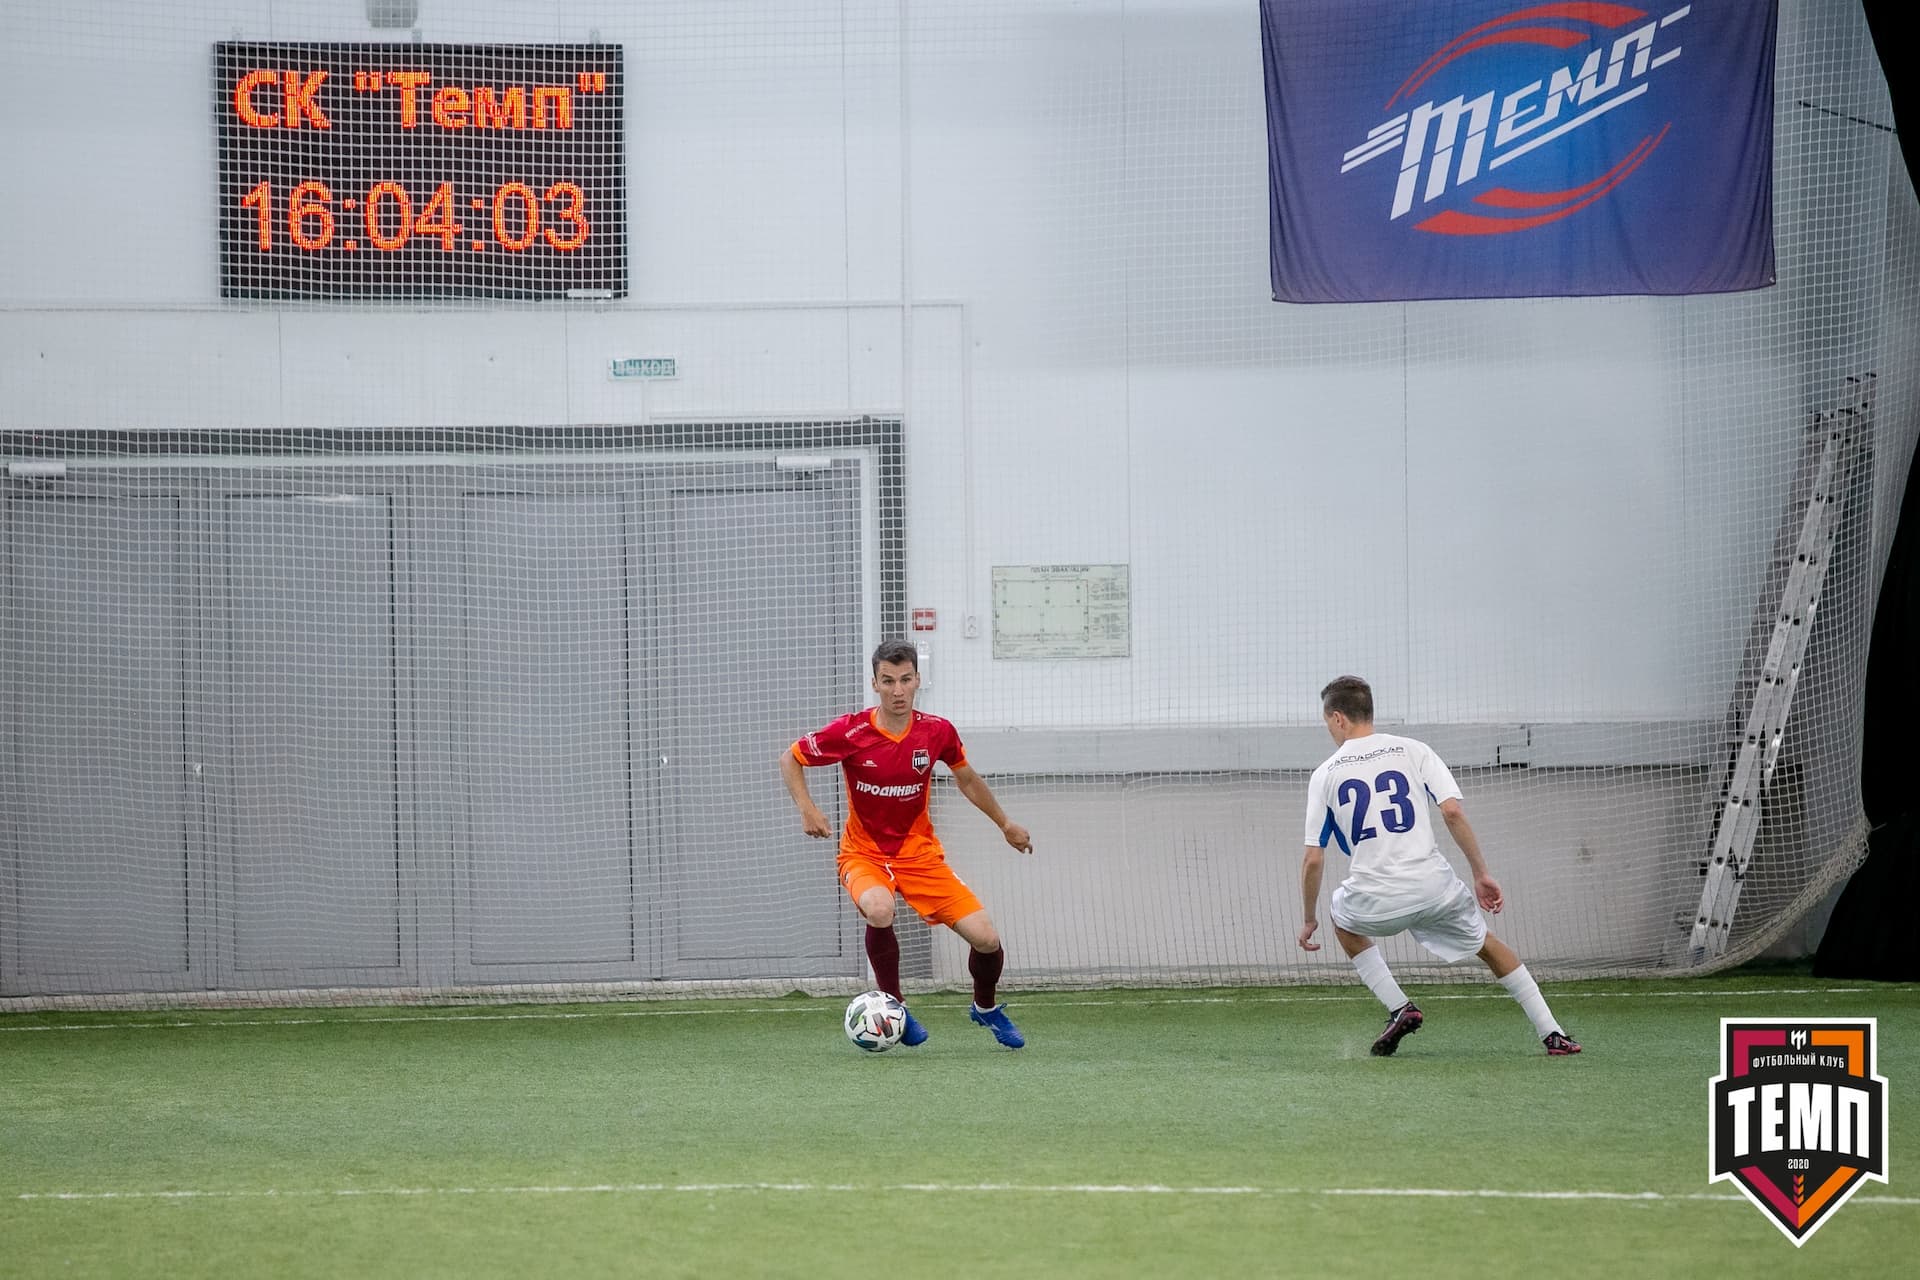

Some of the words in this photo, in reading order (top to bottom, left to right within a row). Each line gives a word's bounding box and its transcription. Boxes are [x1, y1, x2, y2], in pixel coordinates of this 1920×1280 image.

[233, 70, 331, 128] СК
[355, 71, 606, 129] "Темп"
[242, 181, 591, 251] 16:04:03
[1338, 770, 1415, 846] 23
